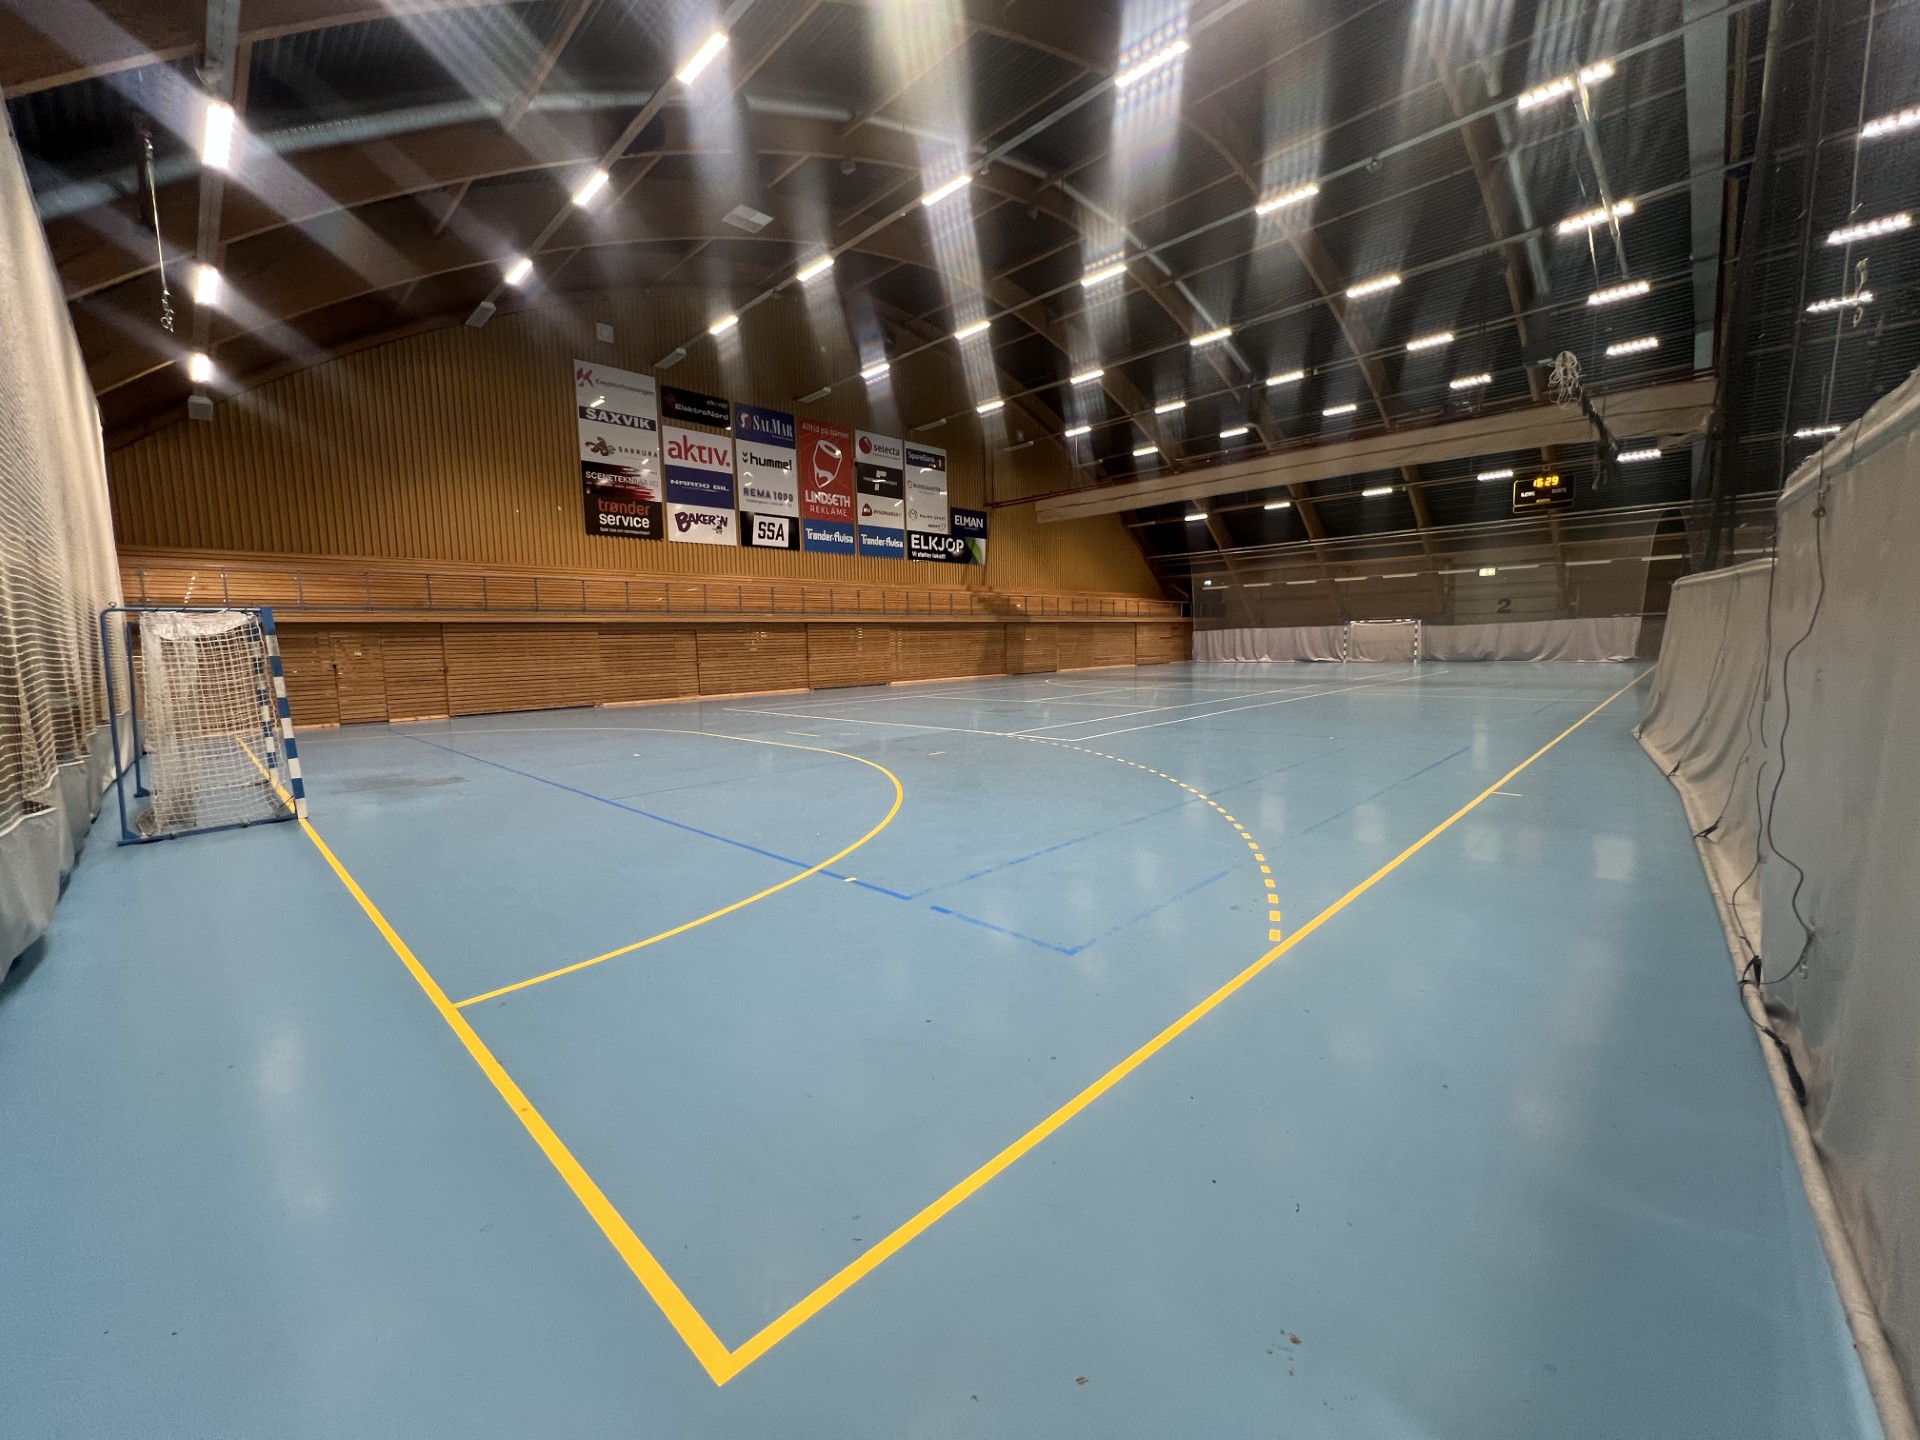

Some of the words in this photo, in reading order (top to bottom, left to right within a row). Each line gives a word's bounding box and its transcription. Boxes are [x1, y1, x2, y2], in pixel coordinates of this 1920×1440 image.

[585, 408, 651, 430] SAXVIK
[674, 403, 729, 421] ElektroNord
[618, 446, 658, 458] SABRURA
[873, 444, 901, 457] selecta
[749, 452, 793, 471] hummel
[669, 479, 710, 489] NARDO
[743, 487, 771, 500] REMA
[773, 491, 794, 502] 1000
[804, 490, 851, 508] LINDSETH
[597, 497, 651, 516] trønder
[809, 505, 848, 517] REKLAME
[598, 513, 650, 529] service
[954, 514, 984, 529] ELMAN
[757, 521, 785, 542] SSA
[1496, 598, 1512, 614] 2
